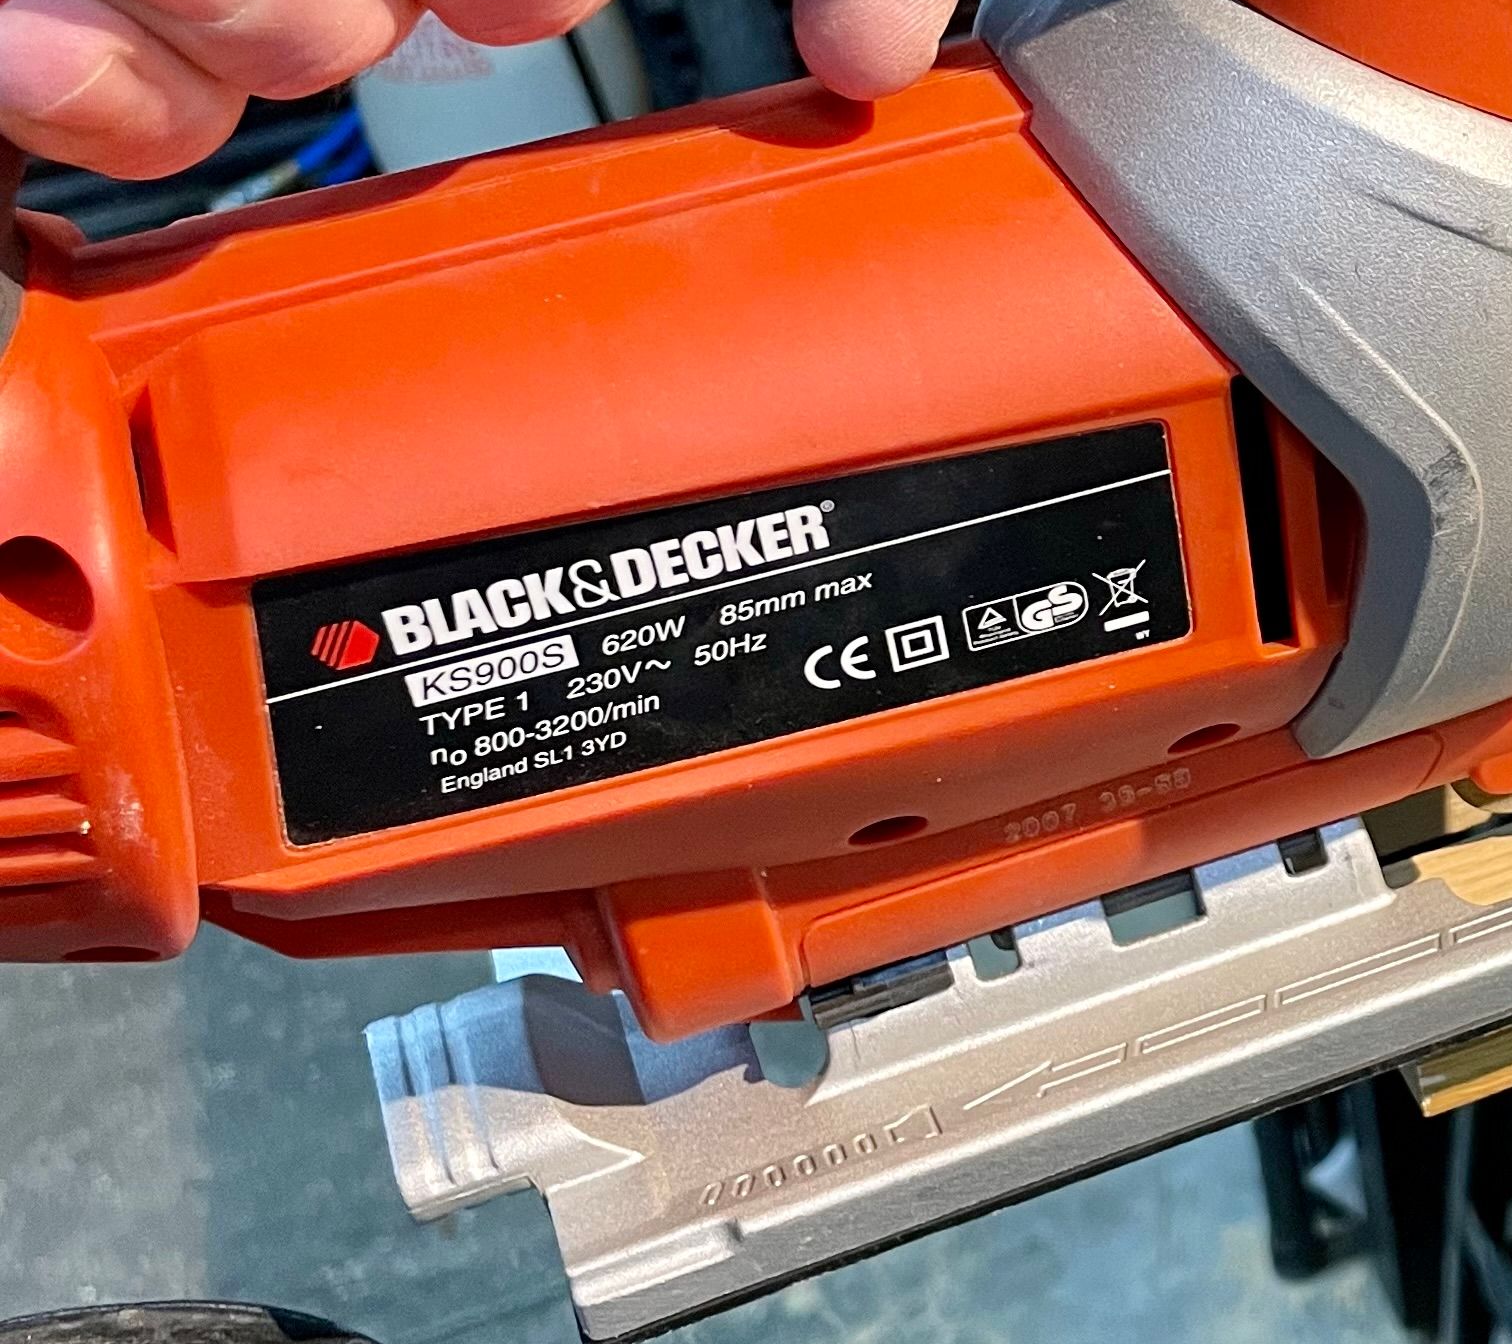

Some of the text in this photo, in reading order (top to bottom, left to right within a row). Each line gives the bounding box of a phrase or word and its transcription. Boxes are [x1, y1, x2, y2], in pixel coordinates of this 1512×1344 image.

[422, 572, 873, 701] KS900S 620W 85mm max
[418, 696, 505, 736] TYPE
[516, 691, 528, 711] 1
[693, 632, 767, 667] 50Hz
[474, 693, 661, 757] 800-3200/min
[440, 731, 627, 795] England SL1 3YD
